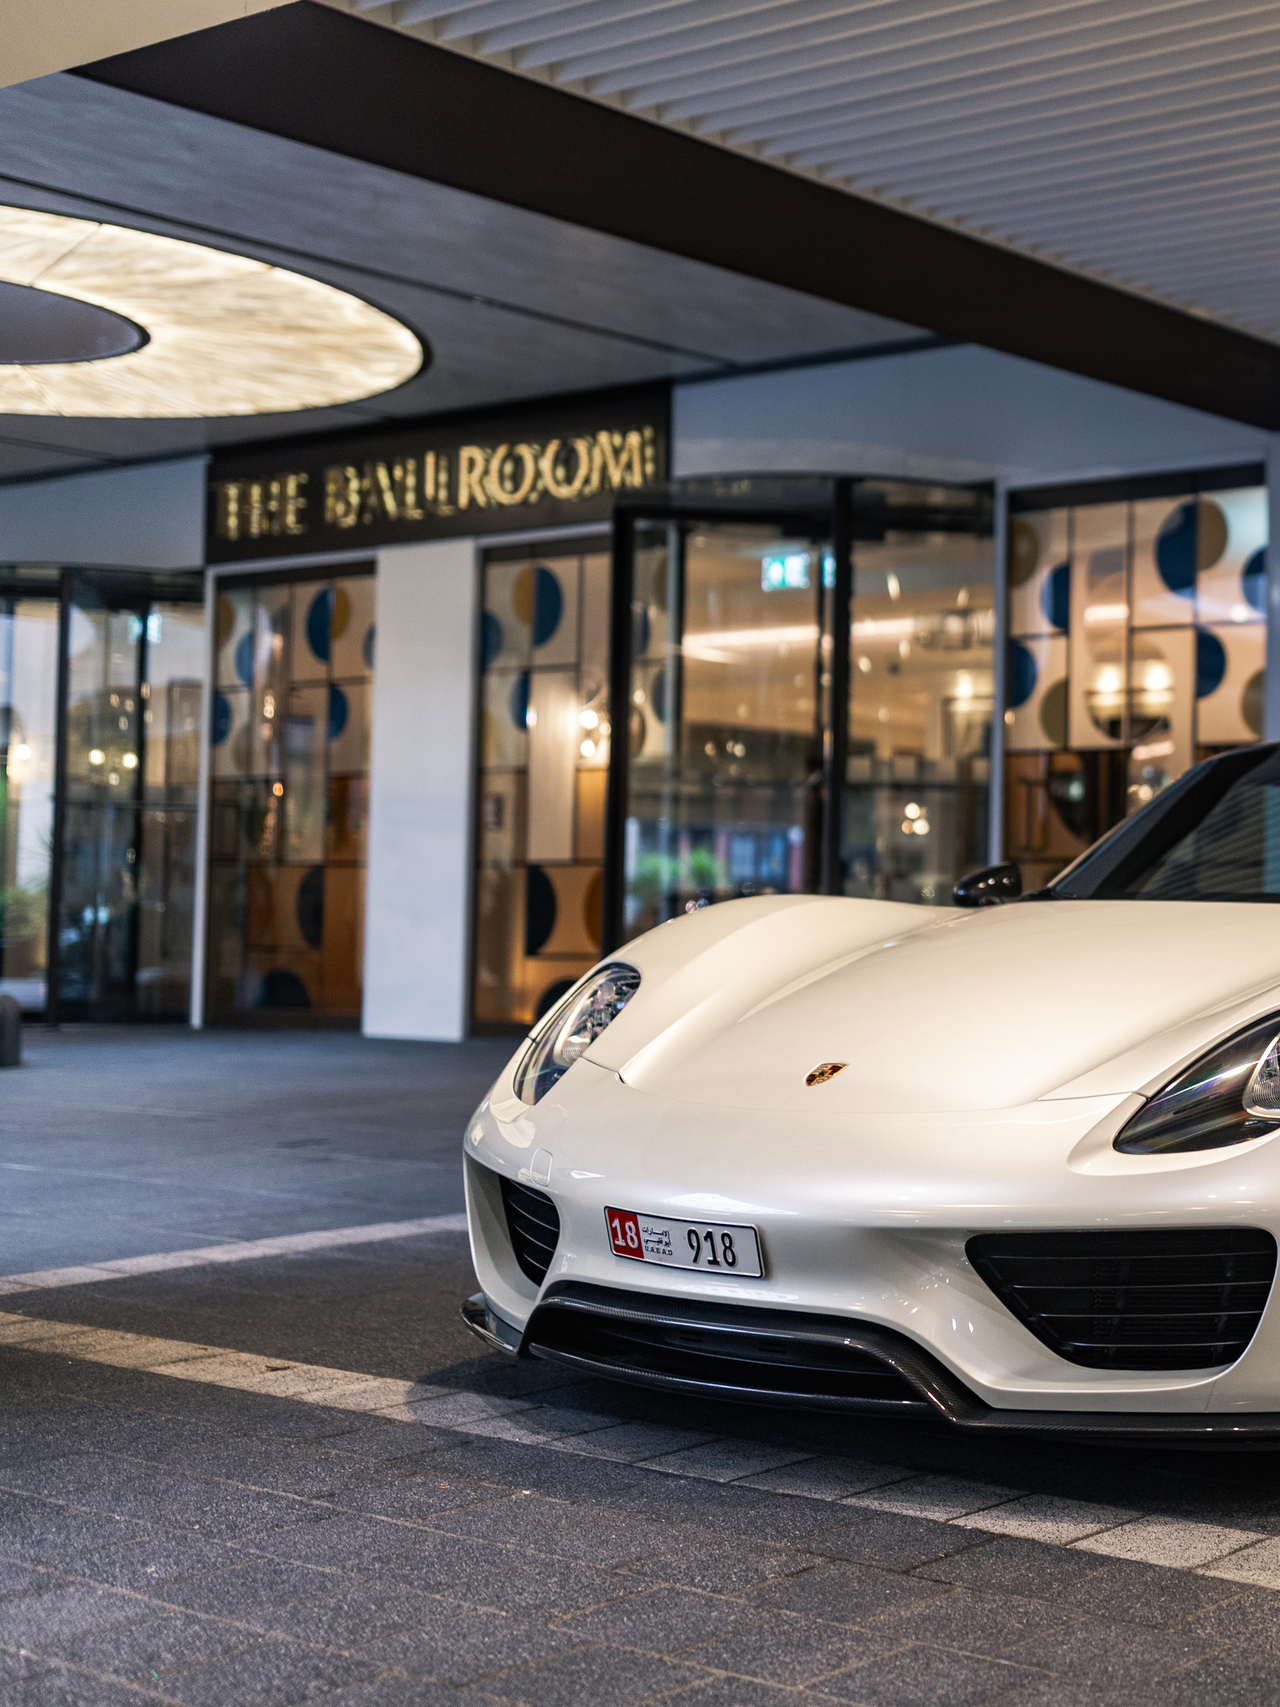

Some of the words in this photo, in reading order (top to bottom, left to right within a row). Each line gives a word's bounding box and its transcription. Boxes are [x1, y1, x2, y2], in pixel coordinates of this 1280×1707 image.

[217, 473, 308, 540] THE
[323, 425, 656, 529] BALLROOM
[611, 1217, 639, 1249] 18
[687, 1227, 738, 1267] 918
